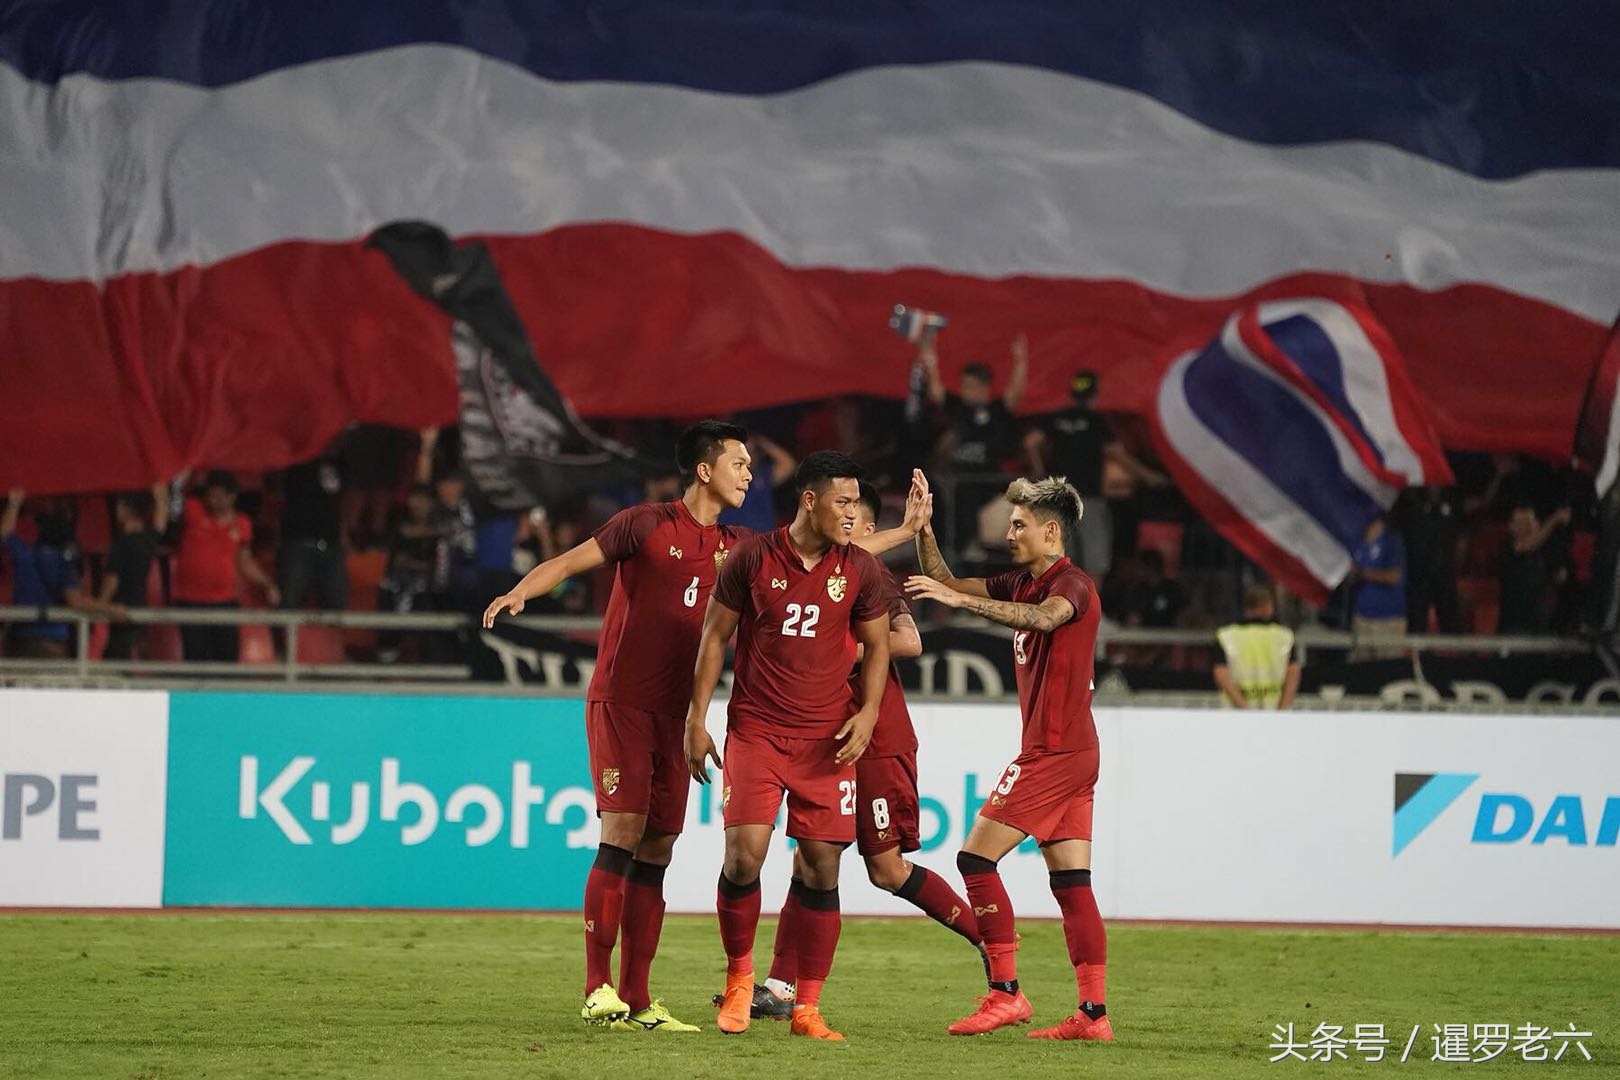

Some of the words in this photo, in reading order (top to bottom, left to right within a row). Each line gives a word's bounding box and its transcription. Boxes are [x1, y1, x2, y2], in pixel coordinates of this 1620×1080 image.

[683, 576, 700, 608] 6
[781, 603, 820, 638] 22
[3, 774, 100, 839] PE
[239, 755, 601, 849] Kubota
[872, 797, 890, 830] 8
